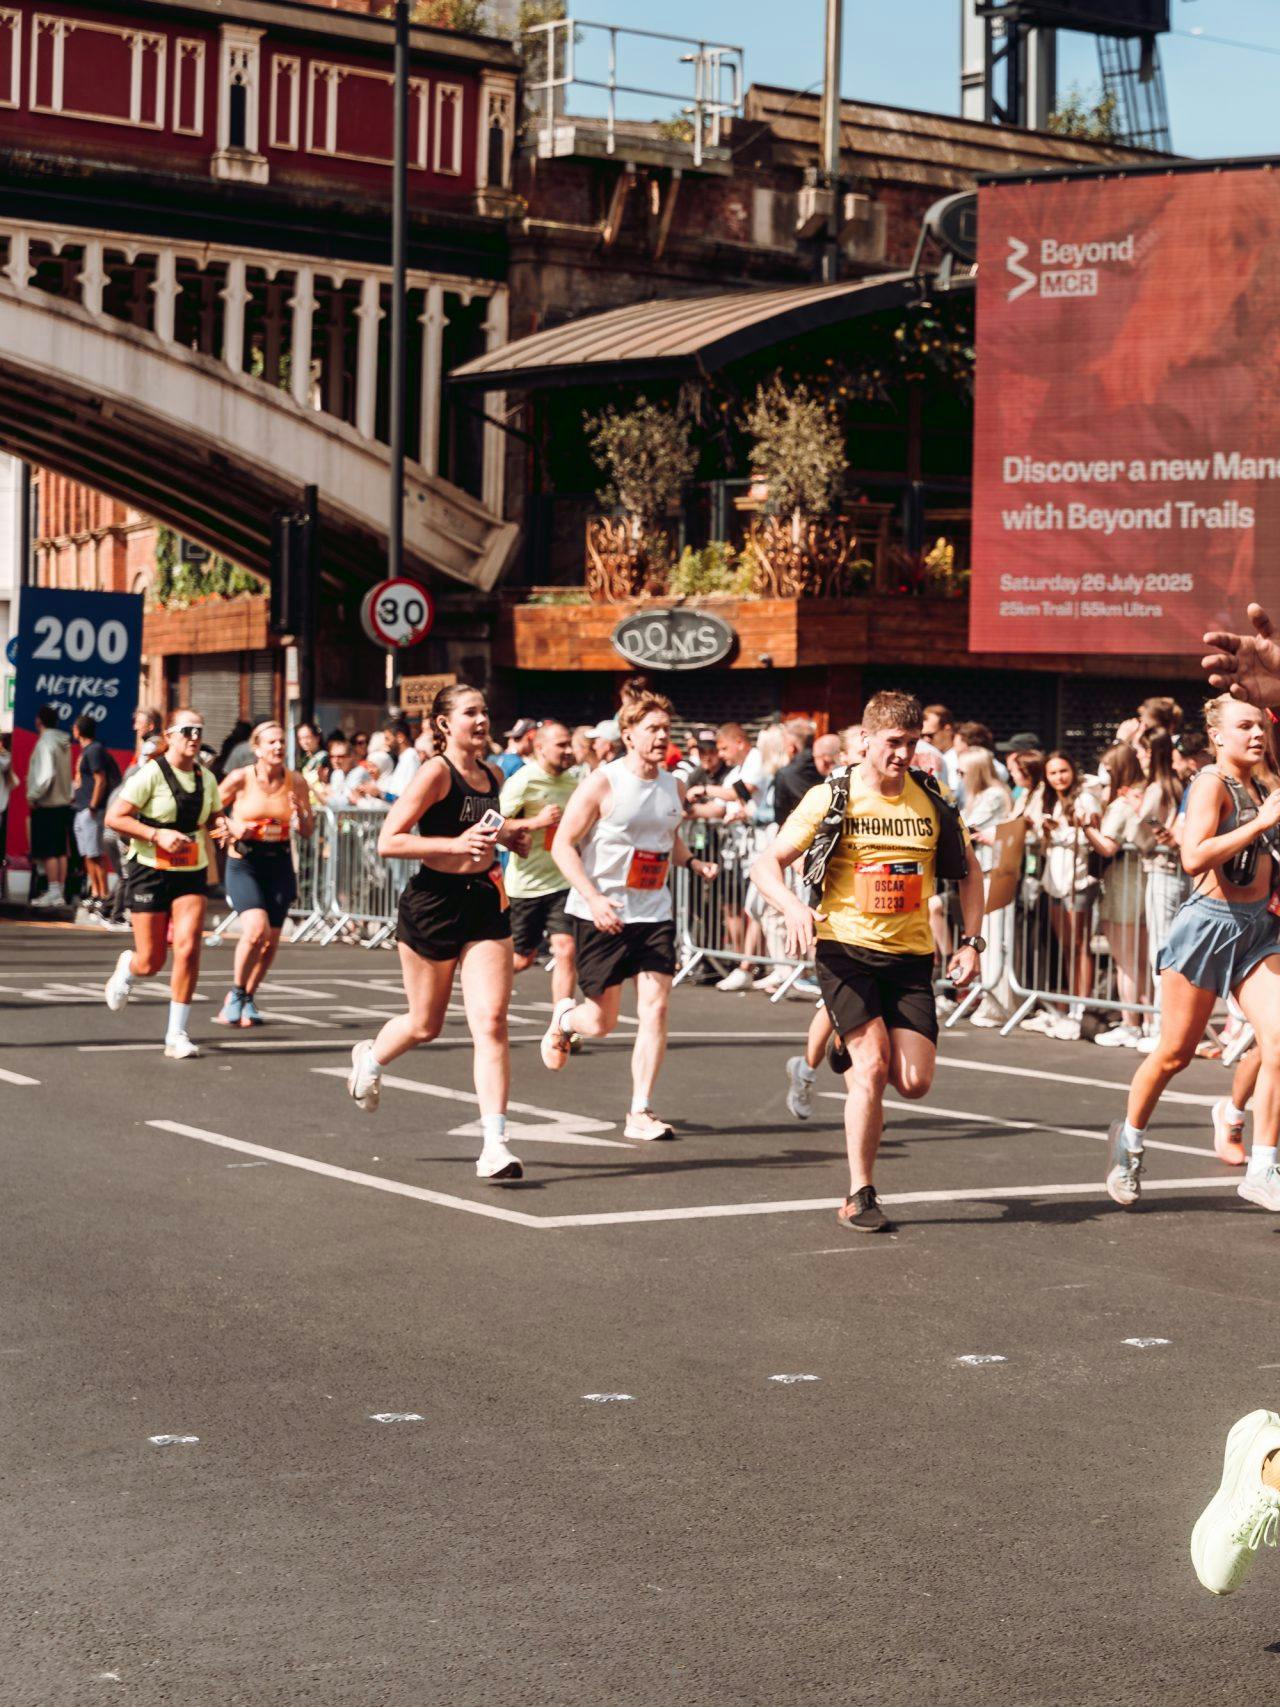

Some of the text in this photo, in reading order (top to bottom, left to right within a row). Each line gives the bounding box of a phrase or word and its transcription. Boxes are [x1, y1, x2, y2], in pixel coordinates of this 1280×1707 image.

[1041, 234, 1134, 269] Beyond
[1044, 273, 1094, 293] MCR
[1002, 456, 1125, 483] Discover
[1127, 460, 1147, 481] a
[1151, 459, 1209, 481] new
[1001, 500, 1255, 535] with Beyond Trails
[1000, 573, 1081, 595] Saturday
[1107, 573, 1144, 595] July
[1145, 573, 1194, 592] 2025
[381, 599, 424, 626] 30
[1042, 600, 1073, 616] Trail
[1124, 602, 1163, 617] Ultra
[32, 615, 129, 664] 200
[35, 673, 120, 698] METRES
[844, 817, 934, 837] INNOMOTICS
[874, 880, 905, 892] OSCAR
